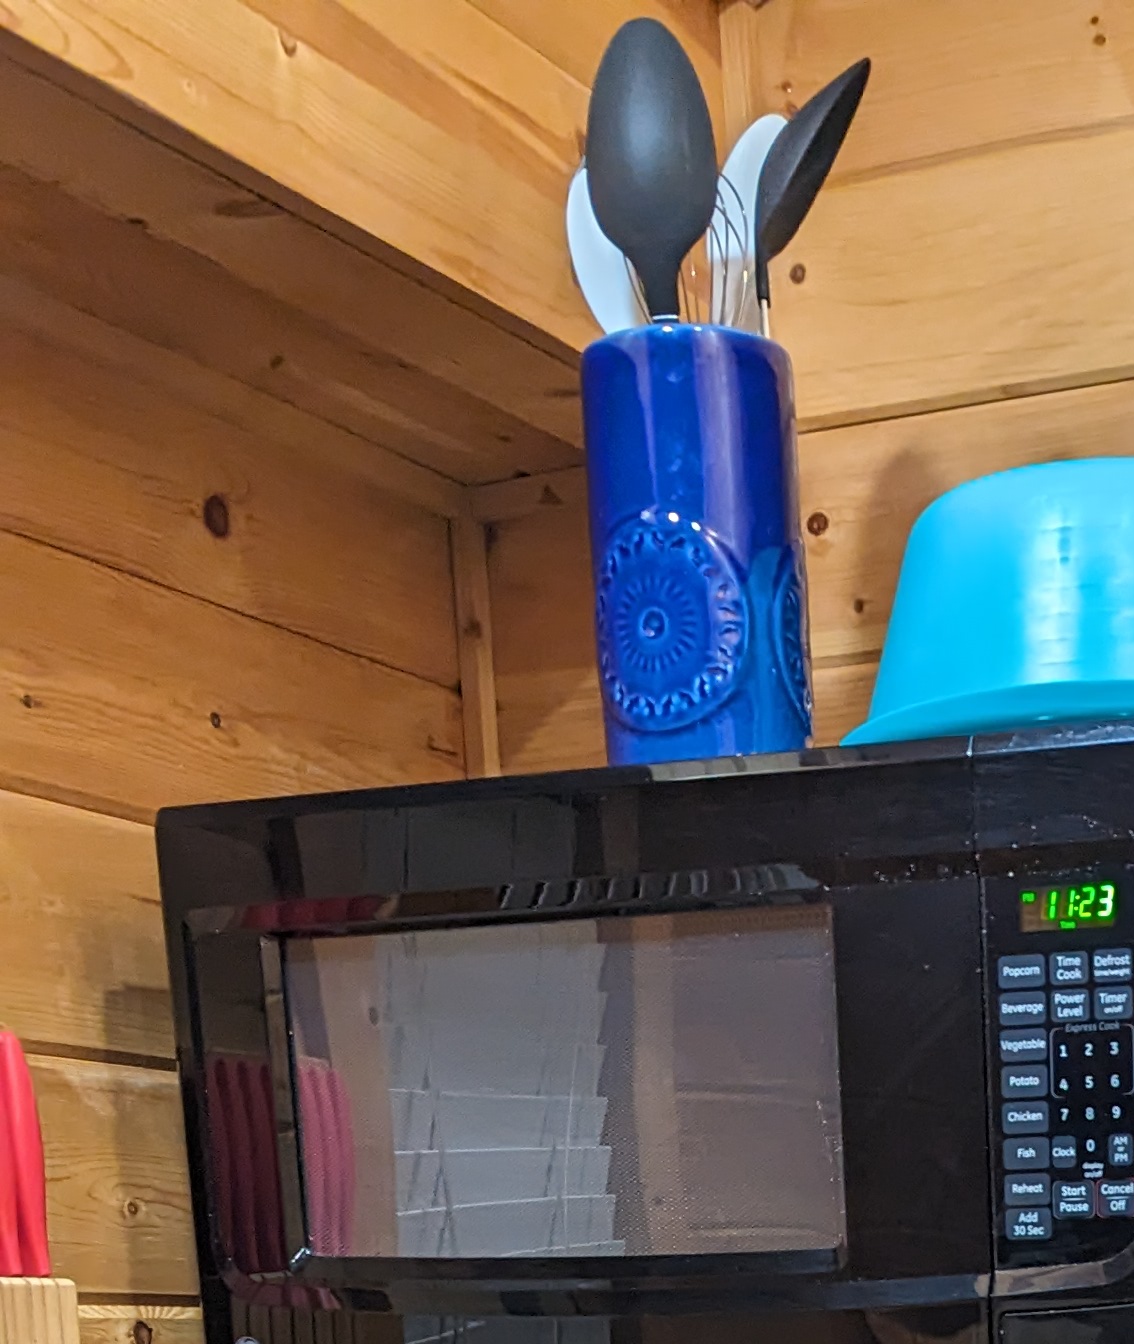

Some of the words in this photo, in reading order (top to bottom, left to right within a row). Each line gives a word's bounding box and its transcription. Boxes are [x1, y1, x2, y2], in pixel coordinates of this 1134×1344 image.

[1049, 885, 1115, 919] 11:23
[1056, 956, 1081, 966] Time
[1094, 954, 1130, 967] Defrost
[1003, 966, 1040, 977] Popcorn
[1056, 969, 1082, 980] Cook
[1054, 993, 1086, 1005] Power
[1099, 992, 1127, 1004] Timer
[1001, 1003, 1043, 1015] Beverage
[1057, 1006, 1083, 1018] Level
[1065, 1023, 1097, 1034] Express
[1099, 1022, 1120, 1031] Cook
[1000, 1038, 1046, 1053] Vegetable
[1059, 1045, 1068, 1058] 1
[1084, 1043, 1093, 1056] 2
[1109, 1041, 1119, 1055] 3
[1009, 1076, 1039, 1086] Potato
[1059, 1078, 1068, 1091] 4
[1085, 1076, 1094, 1089] 5
[1110, 1074, 1120, 1088] 6
[1007, 1110, 1043, 1122] Chicken
[1060, 1108, 1070, 1121] 7
[1085, 1107, 1095, 1120] 8
[1111, 1105, 1121, 1119] 9
[1086, 1139, 1096, 1152] 0
[1113, 1136, 1128, 1146] AM
[1017, 1148, 1036, 1158] Fish
[1052, 1147, 1076, 1157] Clock
[1114, 1153, 1128, 1162] PM
[1012, 1184, 1043, 1193] Reheat
[1061, 1186, 1086, 1197] Start
[1101, 1183, 1134, 1194] Cancel
[1060, 1202, 1089, 1212] Pause
[1110, 1200, 1126, 1211] Off
[1018, 1212, 1038, 1223] Add
[1013, 1226, 1026, 1236] 30
[1027, 1225, 1045, 1235] Sec
